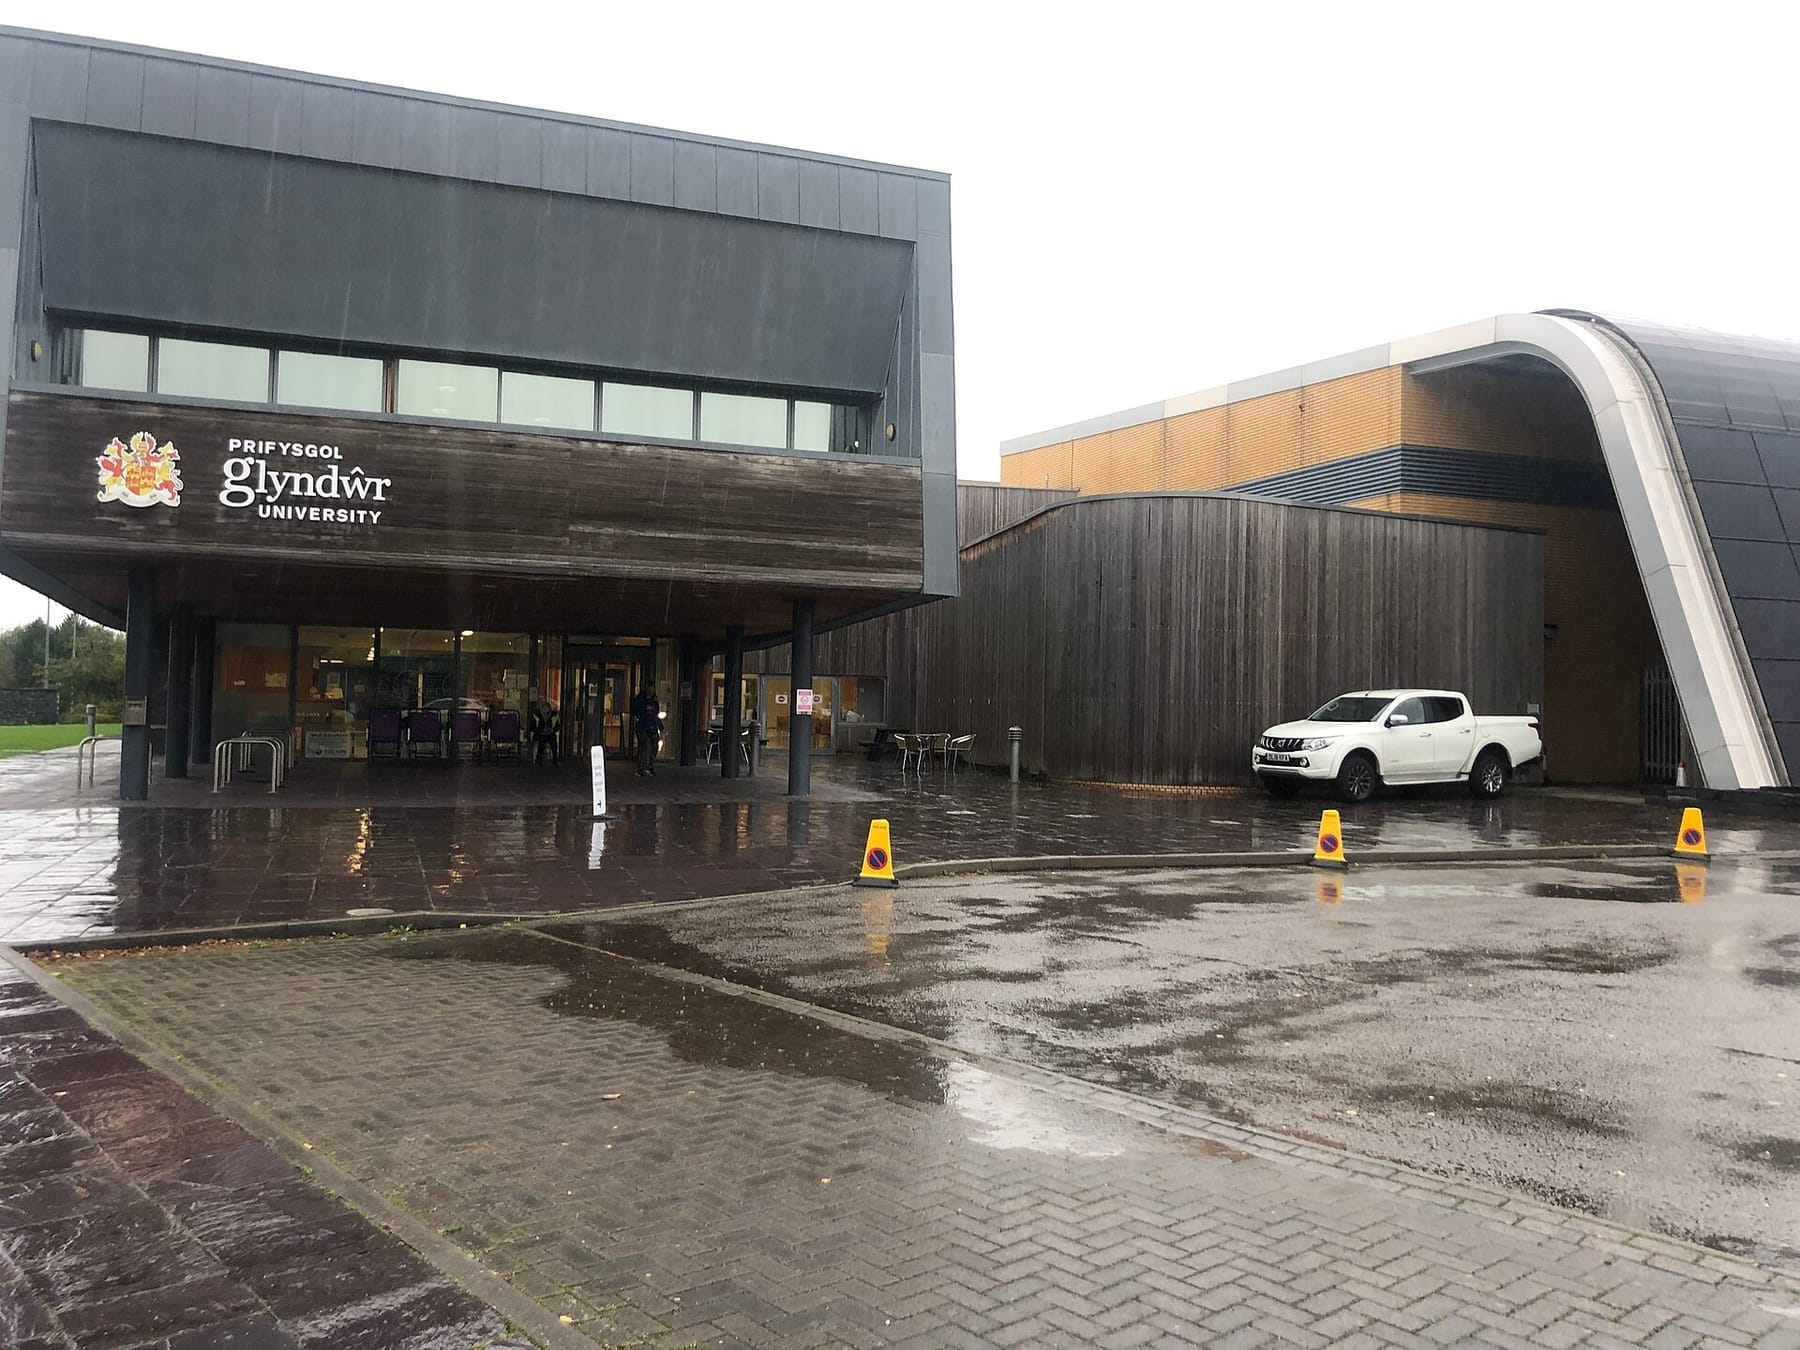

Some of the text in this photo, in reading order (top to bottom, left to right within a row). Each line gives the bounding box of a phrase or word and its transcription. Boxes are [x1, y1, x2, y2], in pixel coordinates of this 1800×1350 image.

[228, 438, 344, 459] PRIFYSGOL
[218, 456, 392, 508] glyndŵr
[258, 504, 382, 524] UNIVERSITY
